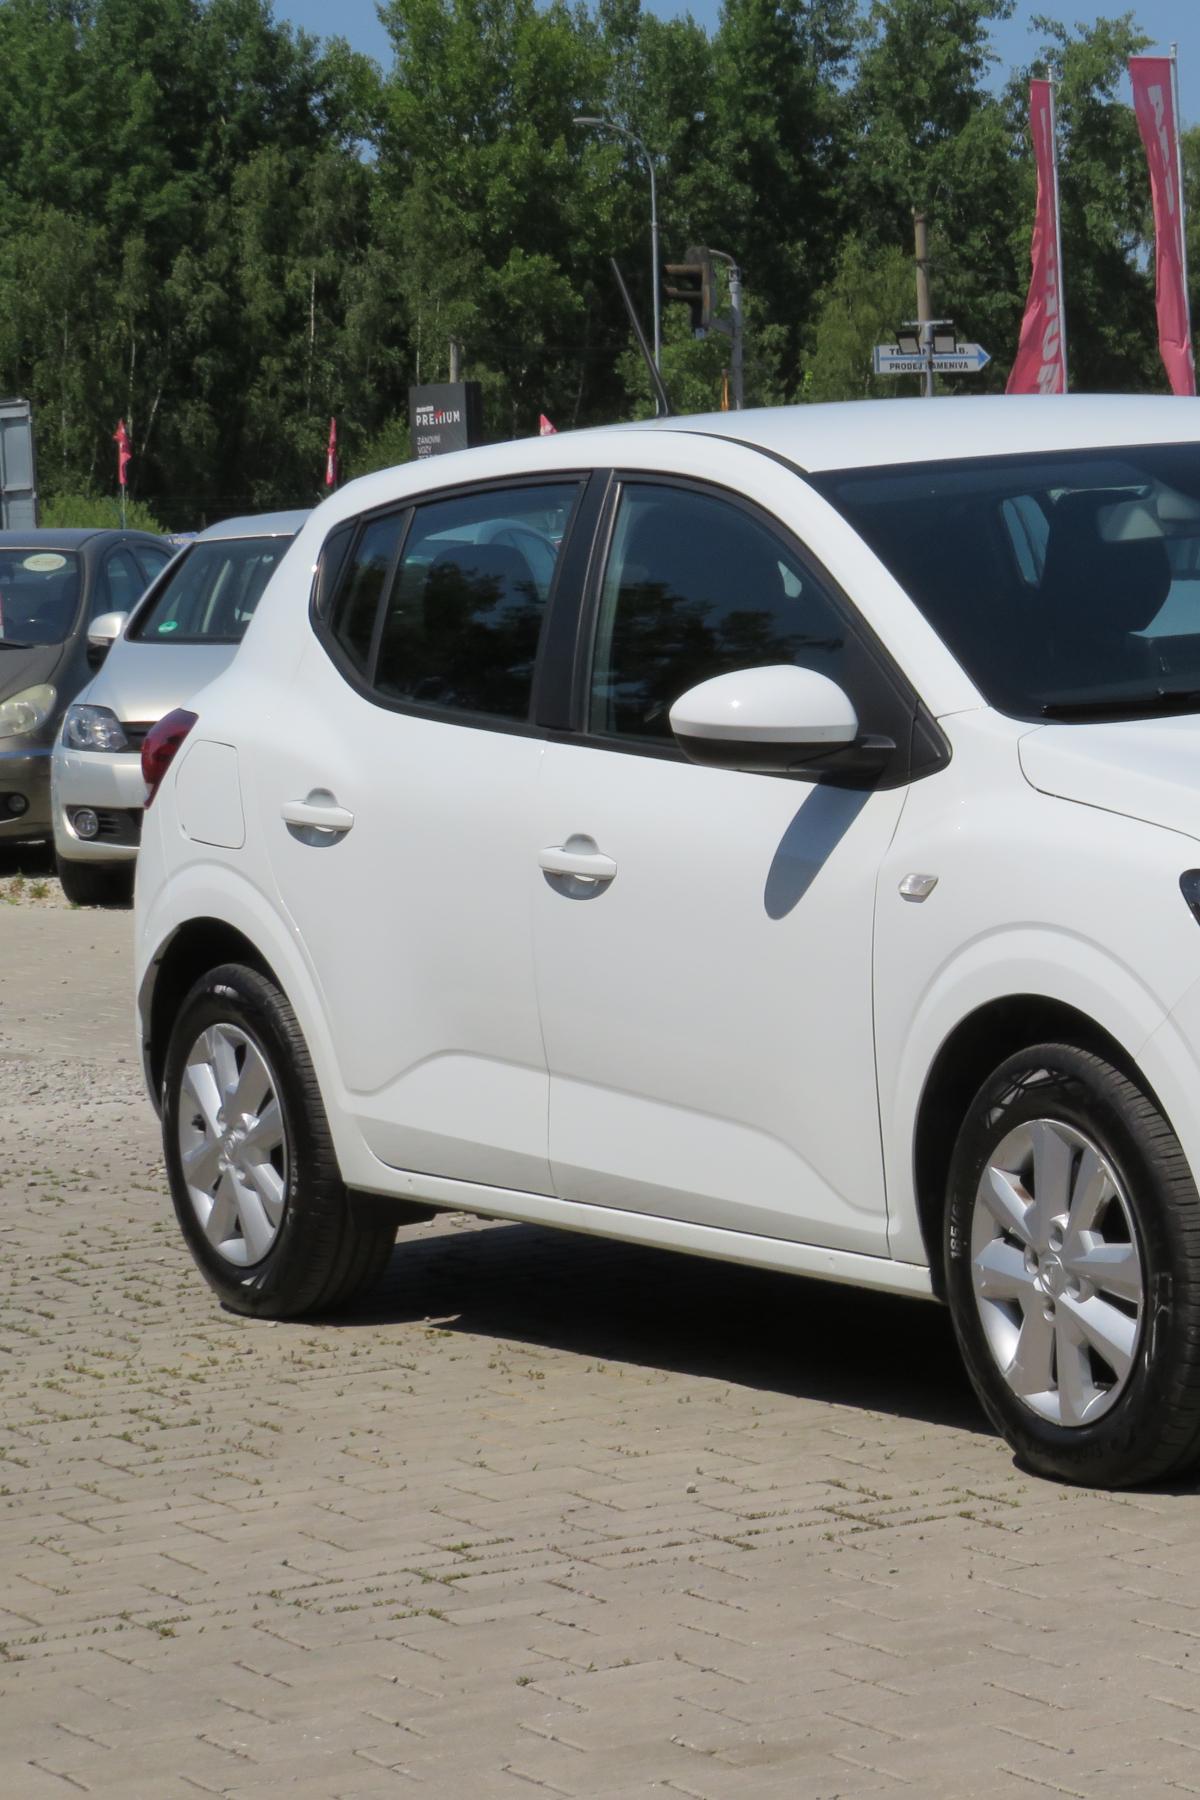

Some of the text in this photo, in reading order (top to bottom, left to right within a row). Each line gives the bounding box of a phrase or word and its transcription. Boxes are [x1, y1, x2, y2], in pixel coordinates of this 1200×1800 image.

[889, 361, 969, 370] PRODEJ AMENIVA
[416, 410, 461, 427] PREMIUM
